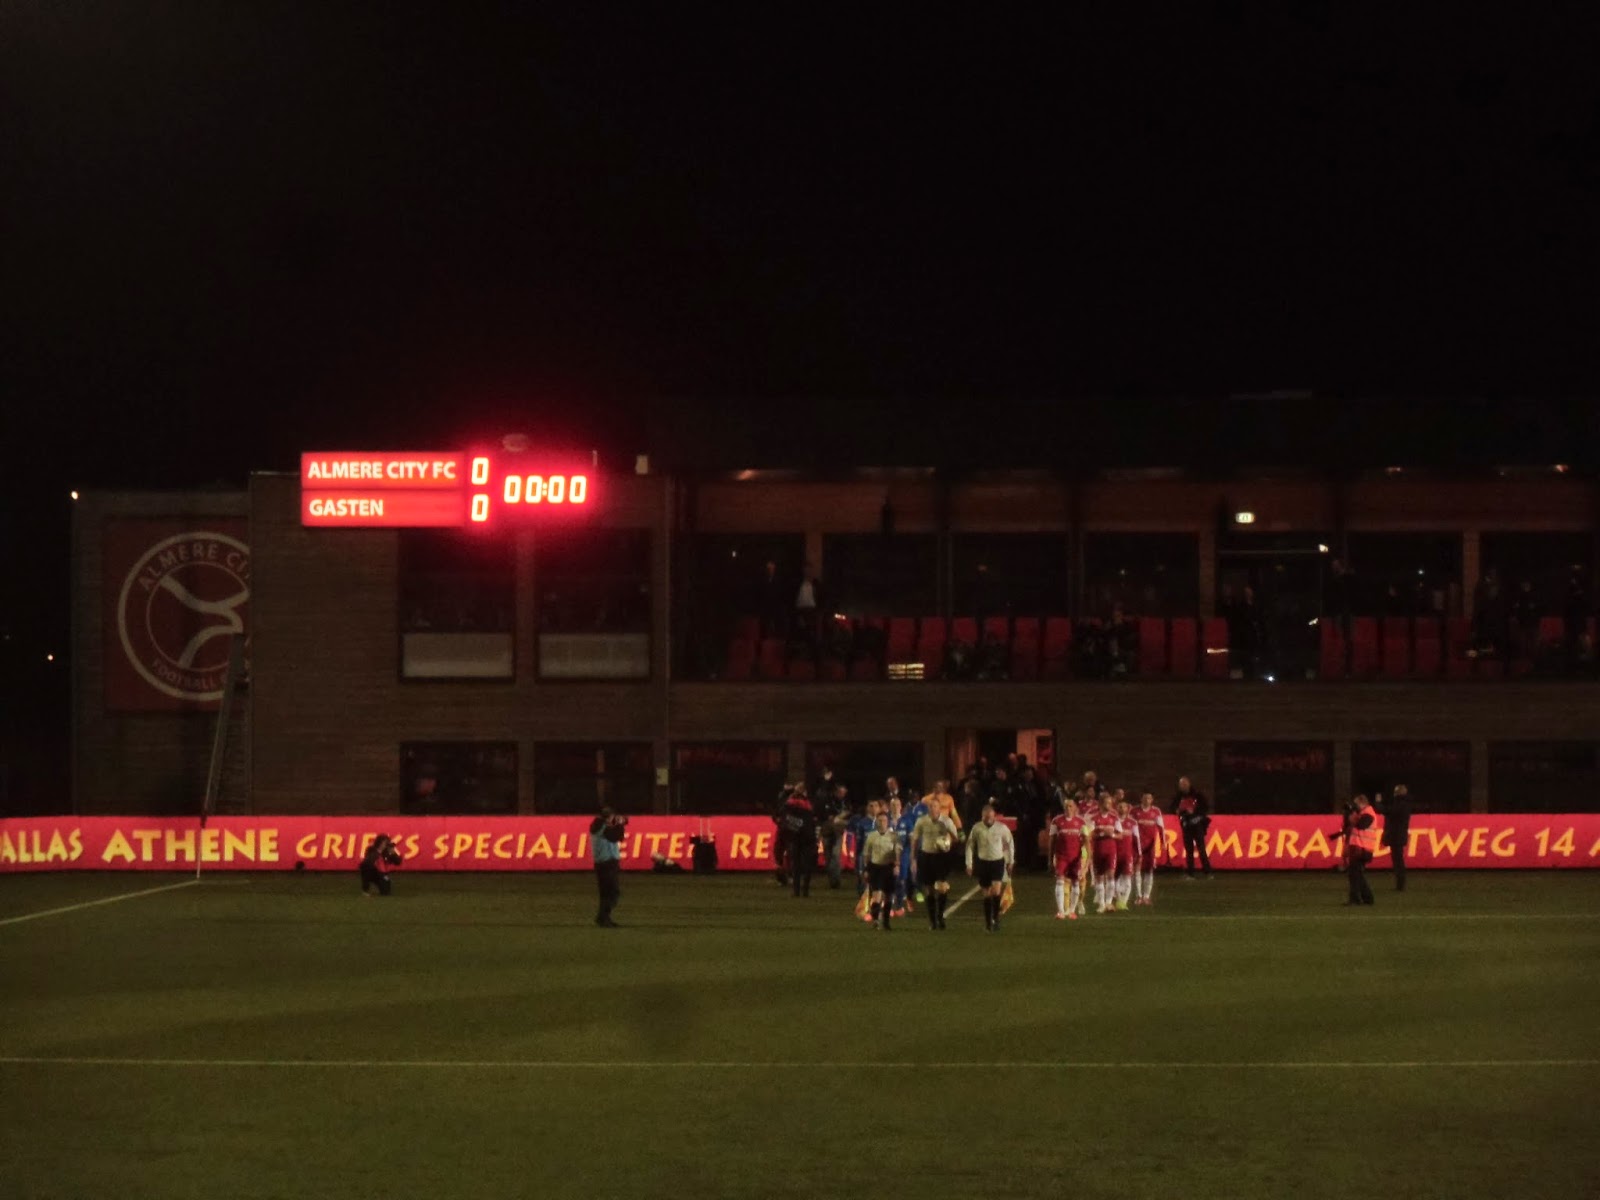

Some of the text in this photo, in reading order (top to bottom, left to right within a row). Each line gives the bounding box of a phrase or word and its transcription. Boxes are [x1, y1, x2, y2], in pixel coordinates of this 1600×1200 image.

[307, 460, 456, 480] ALMERE CITY FC
[471, 456, 490, 486] 0
[503, 474, 588, 504] 00:00
[308, 498, 384, 517] GASTEN
[470, 493, 490, 522] 0
[137, 543, 219, 592] ALMERE
[101, 828, 279, 863] ATHENE
[434, 832, 714, 859] SPECIALIEITE
[1155, 828, 1516, 859] RMBRADTWEG
[1535, 827, 1575, 857] 14
